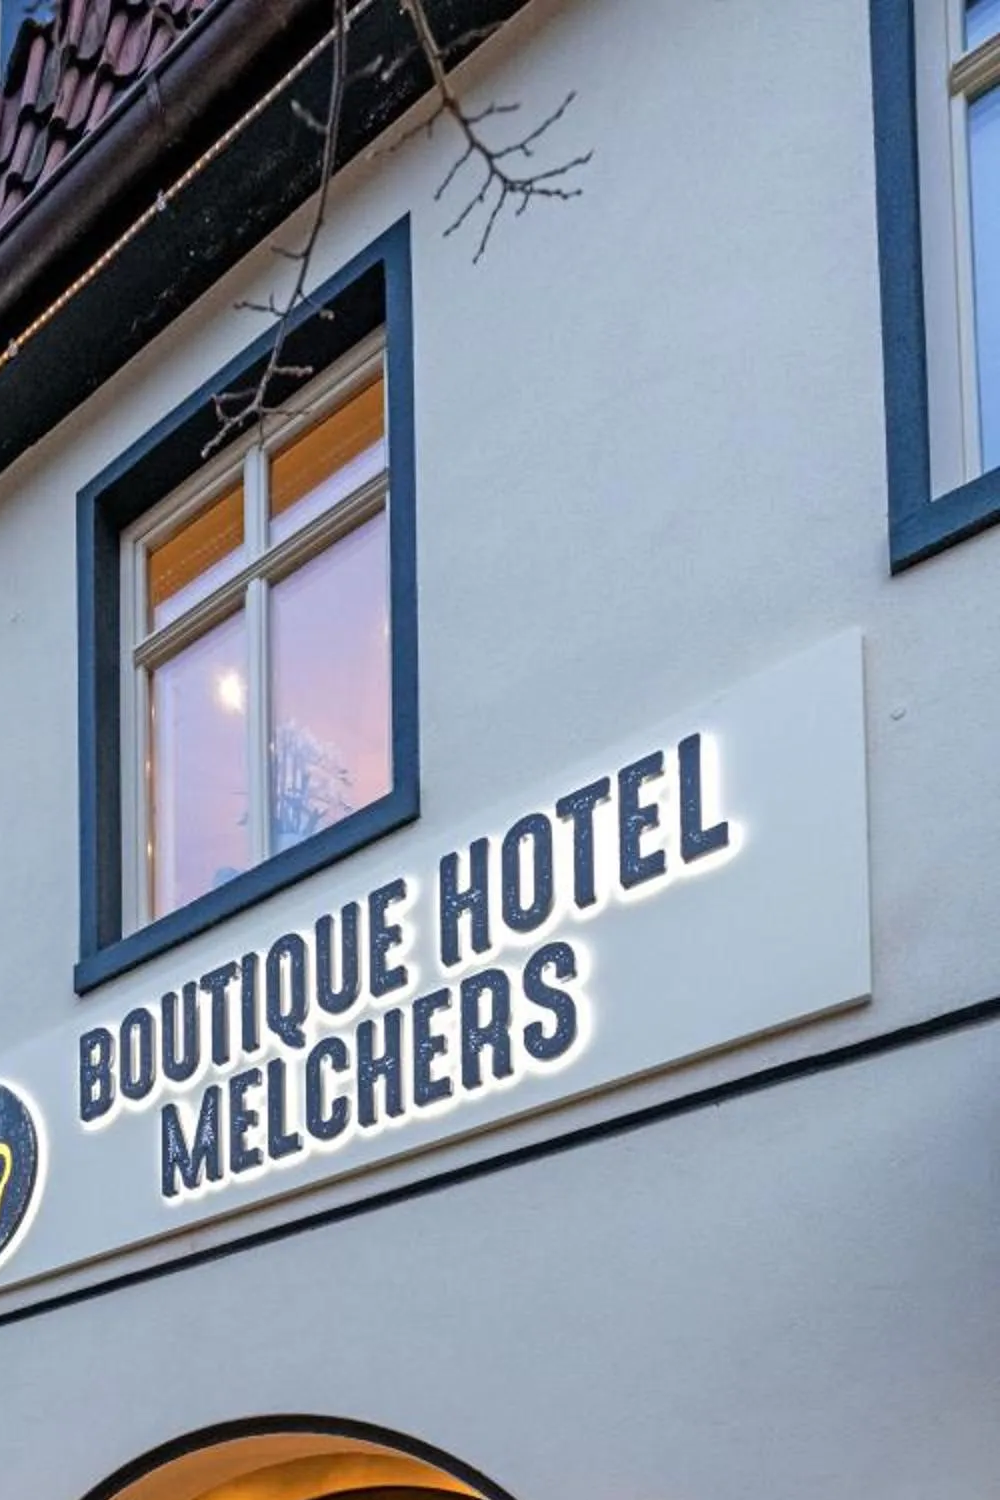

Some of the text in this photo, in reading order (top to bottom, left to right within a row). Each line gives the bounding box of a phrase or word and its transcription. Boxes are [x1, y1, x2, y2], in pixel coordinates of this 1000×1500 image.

[79, 733, 730, 1123] BOUTIQUE HOTEL
[161, 941, 578, 1198] MELCHERS
